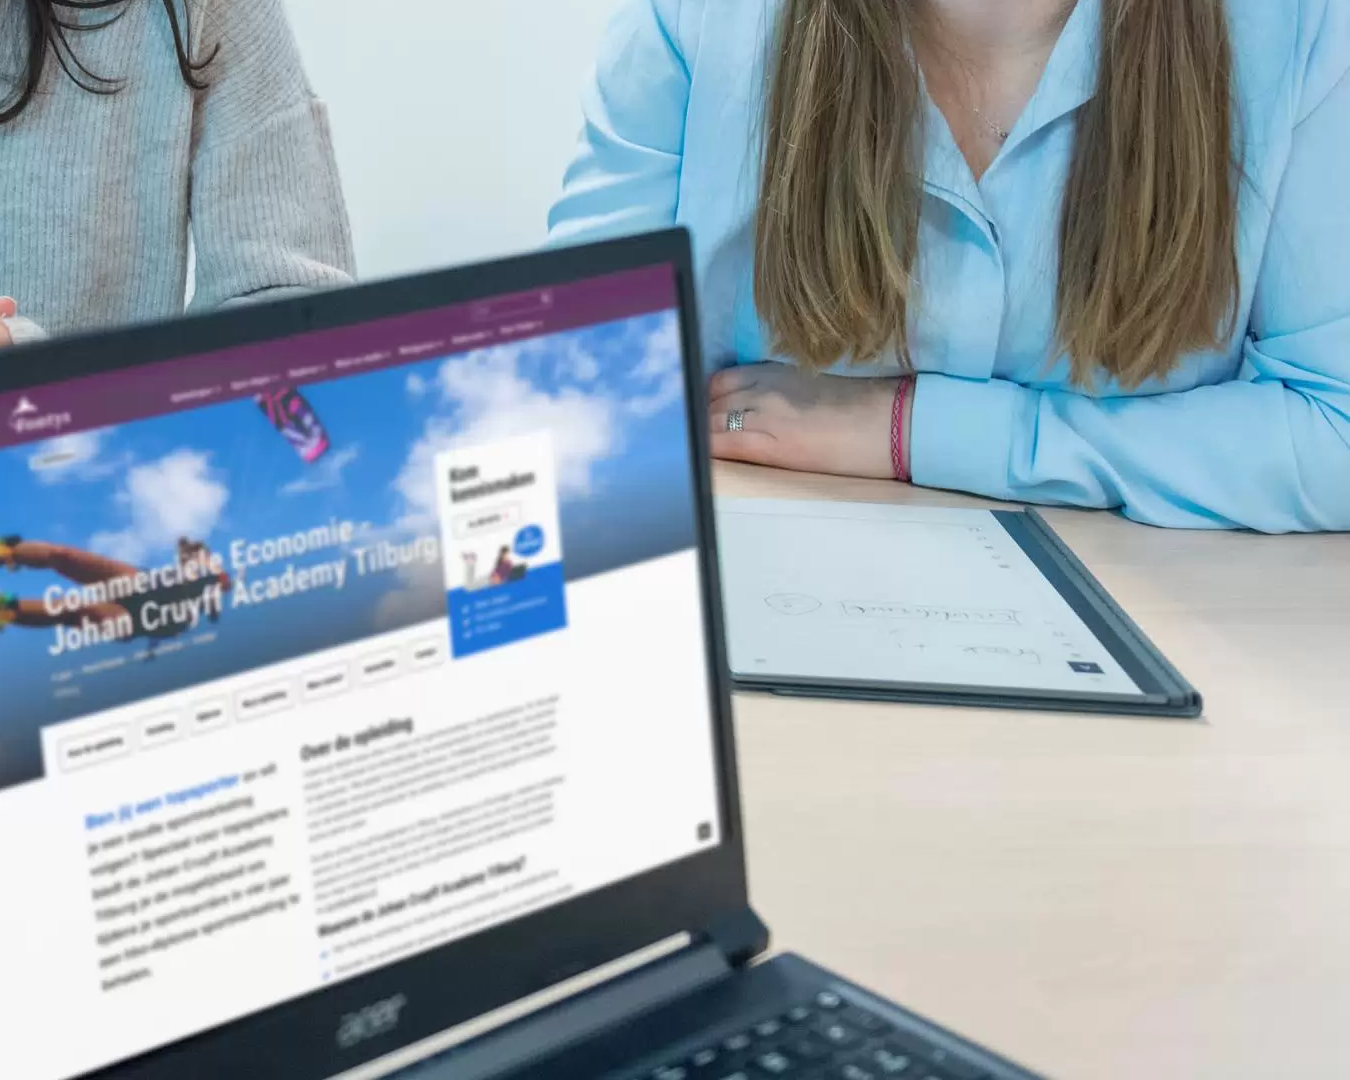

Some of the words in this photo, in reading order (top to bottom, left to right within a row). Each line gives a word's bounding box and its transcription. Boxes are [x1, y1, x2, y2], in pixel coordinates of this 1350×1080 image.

[230, 517, 355, 569] Economie
[47, 613, 134, 657] Johan
[139, 580, 224, 632] Cruyff
[230, 558, 347, 609] Academy
[353, 534, 440, 577] Tilburg
[299, 741, 333, 761] Over
[332, 735, 353, 751] de
[352, 717, 413, 746] opleiding
